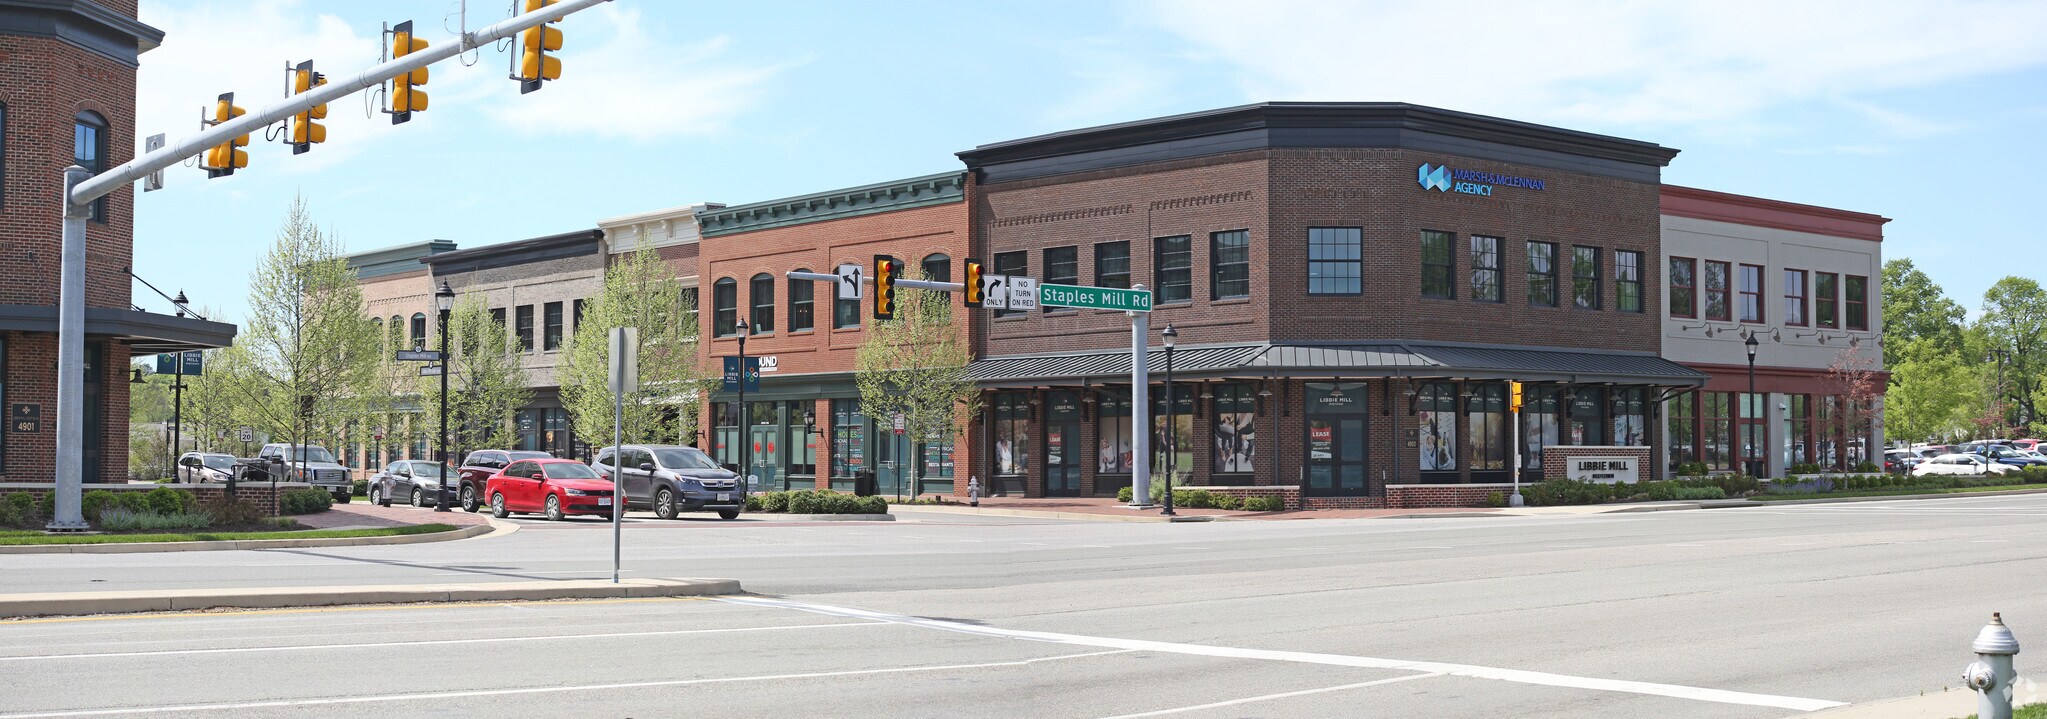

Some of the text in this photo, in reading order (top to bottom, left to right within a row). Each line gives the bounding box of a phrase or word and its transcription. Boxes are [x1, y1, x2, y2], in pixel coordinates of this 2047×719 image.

[1454, 168, 1488, 183] MARSH
[1496, 174, 1545, 191] McLENNAN
[1454, 182, 1492, 196] AGENCY
[1022, 299, 1034, 307] RED
[1044, 288, 1149, 307] Staples Mill Rd
[758, 356, 777, 367] UND
[18, 422, 35, 431] 4901
[1578, 461, 1628, 471] LIBBIE MILL
